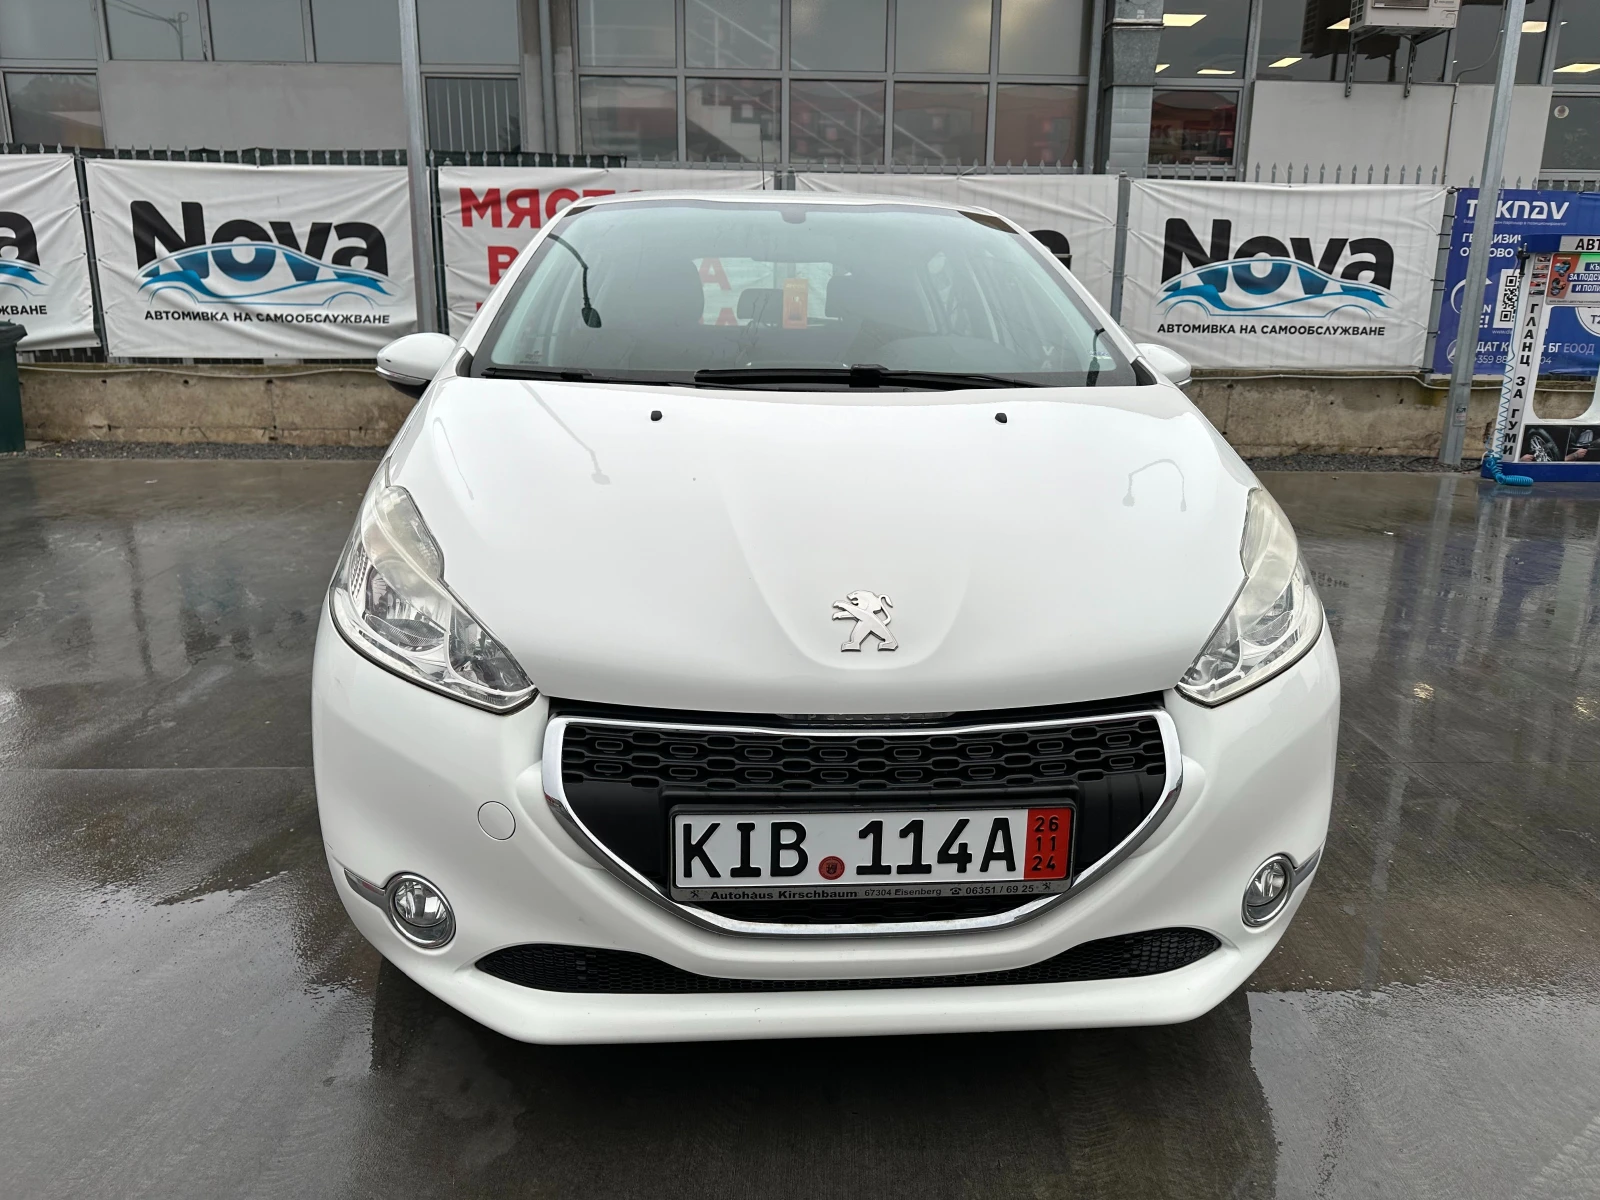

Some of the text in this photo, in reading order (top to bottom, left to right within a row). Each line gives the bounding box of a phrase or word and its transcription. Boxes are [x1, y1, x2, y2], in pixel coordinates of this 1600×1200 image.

[131, 200, 389, 281] Nova
[1161, 217, 1395, 295] Nova
[144, 310, 390, 325] АВТОМИВКА НА САМООБСЛУЖВАНЕ
[1157, 323, 1386, 337] АВТОМИВКА НА САМООБСЛУЖВАНЕ
[1548, 342, 1562, 353] БГ
[1563, 343, 1595, 355] ЕООД
[1502, 303, 1539, 456] ГЛАНЦ ЗА ГУМИ
[1034, 815, 1059, 833] 26
[682, 816, 1017, 879] KIB 114A
[1036, 835, 1056, 852] 11
[1031, 854, 1056, 872] 24
[710, 890, 774, 900] Autohaus
[778, 889, 858, 900] Kirschbaum
[864, 888, 892, 897] 67304
[894, 886, 942, 897] Eisenberg
[965, 886, 996, 895] 06351
[1006, 885, 1019, 894] 69
[1021, 884, 1035, 893] 25
